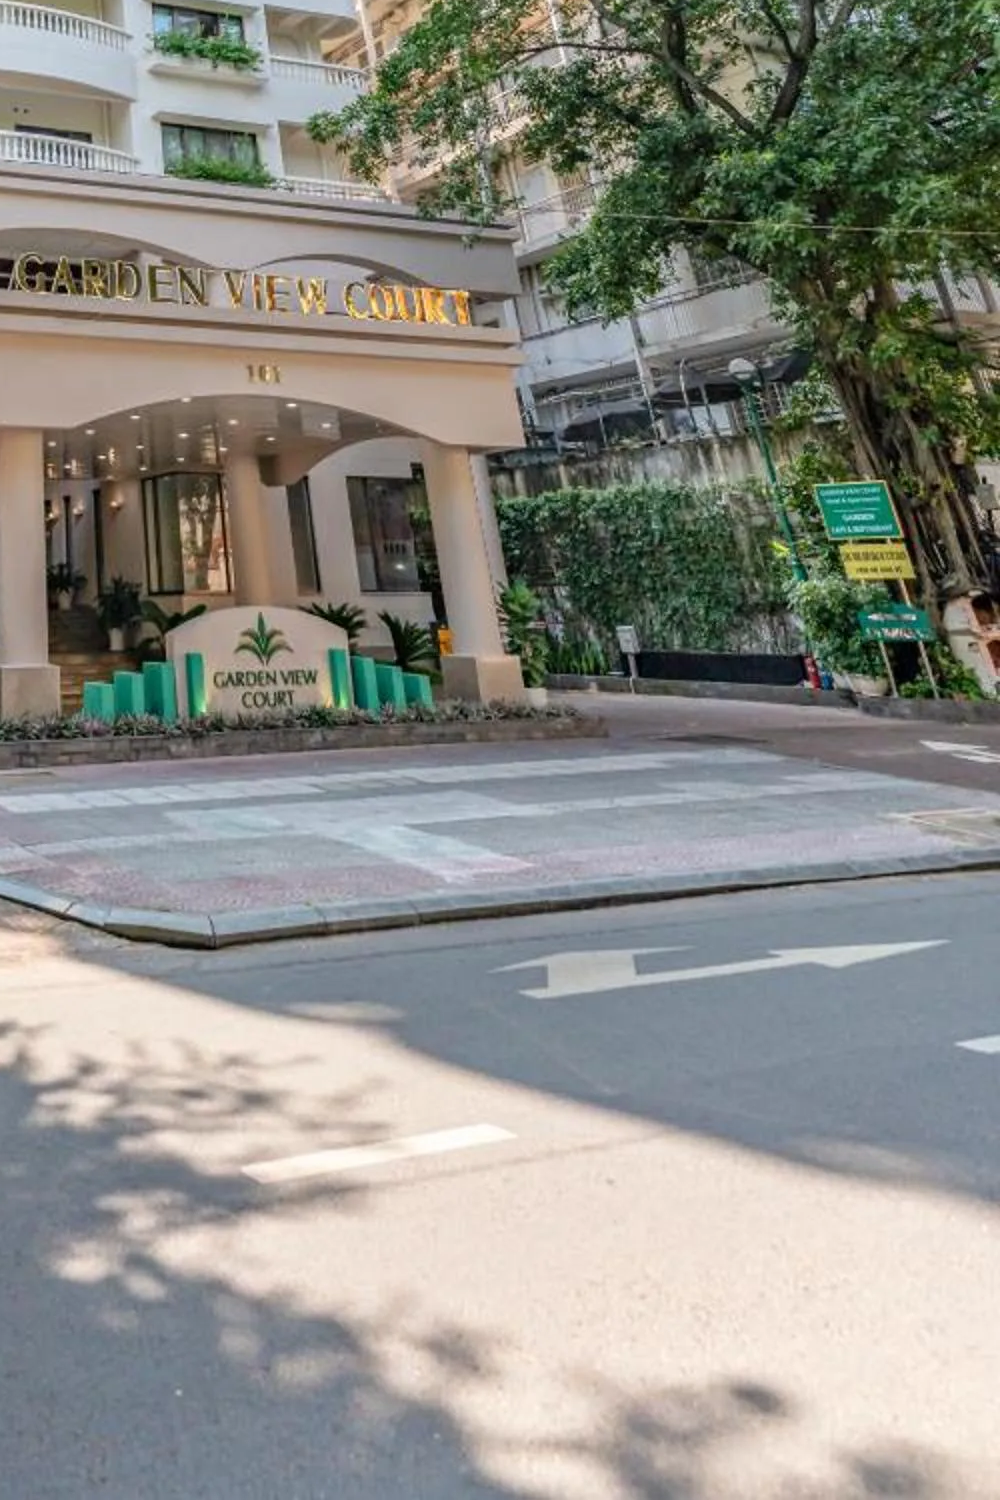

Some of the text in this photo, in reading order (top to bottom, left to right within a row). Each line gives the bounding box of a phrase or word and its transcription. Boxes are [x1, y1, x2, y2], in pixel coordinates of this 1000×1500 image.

[13, 251, 472, 327] GARDEN VIEW COURT
[213, 668, 318, 689] GARDEN VIEW
[241, 690, 294, 709] COURT
